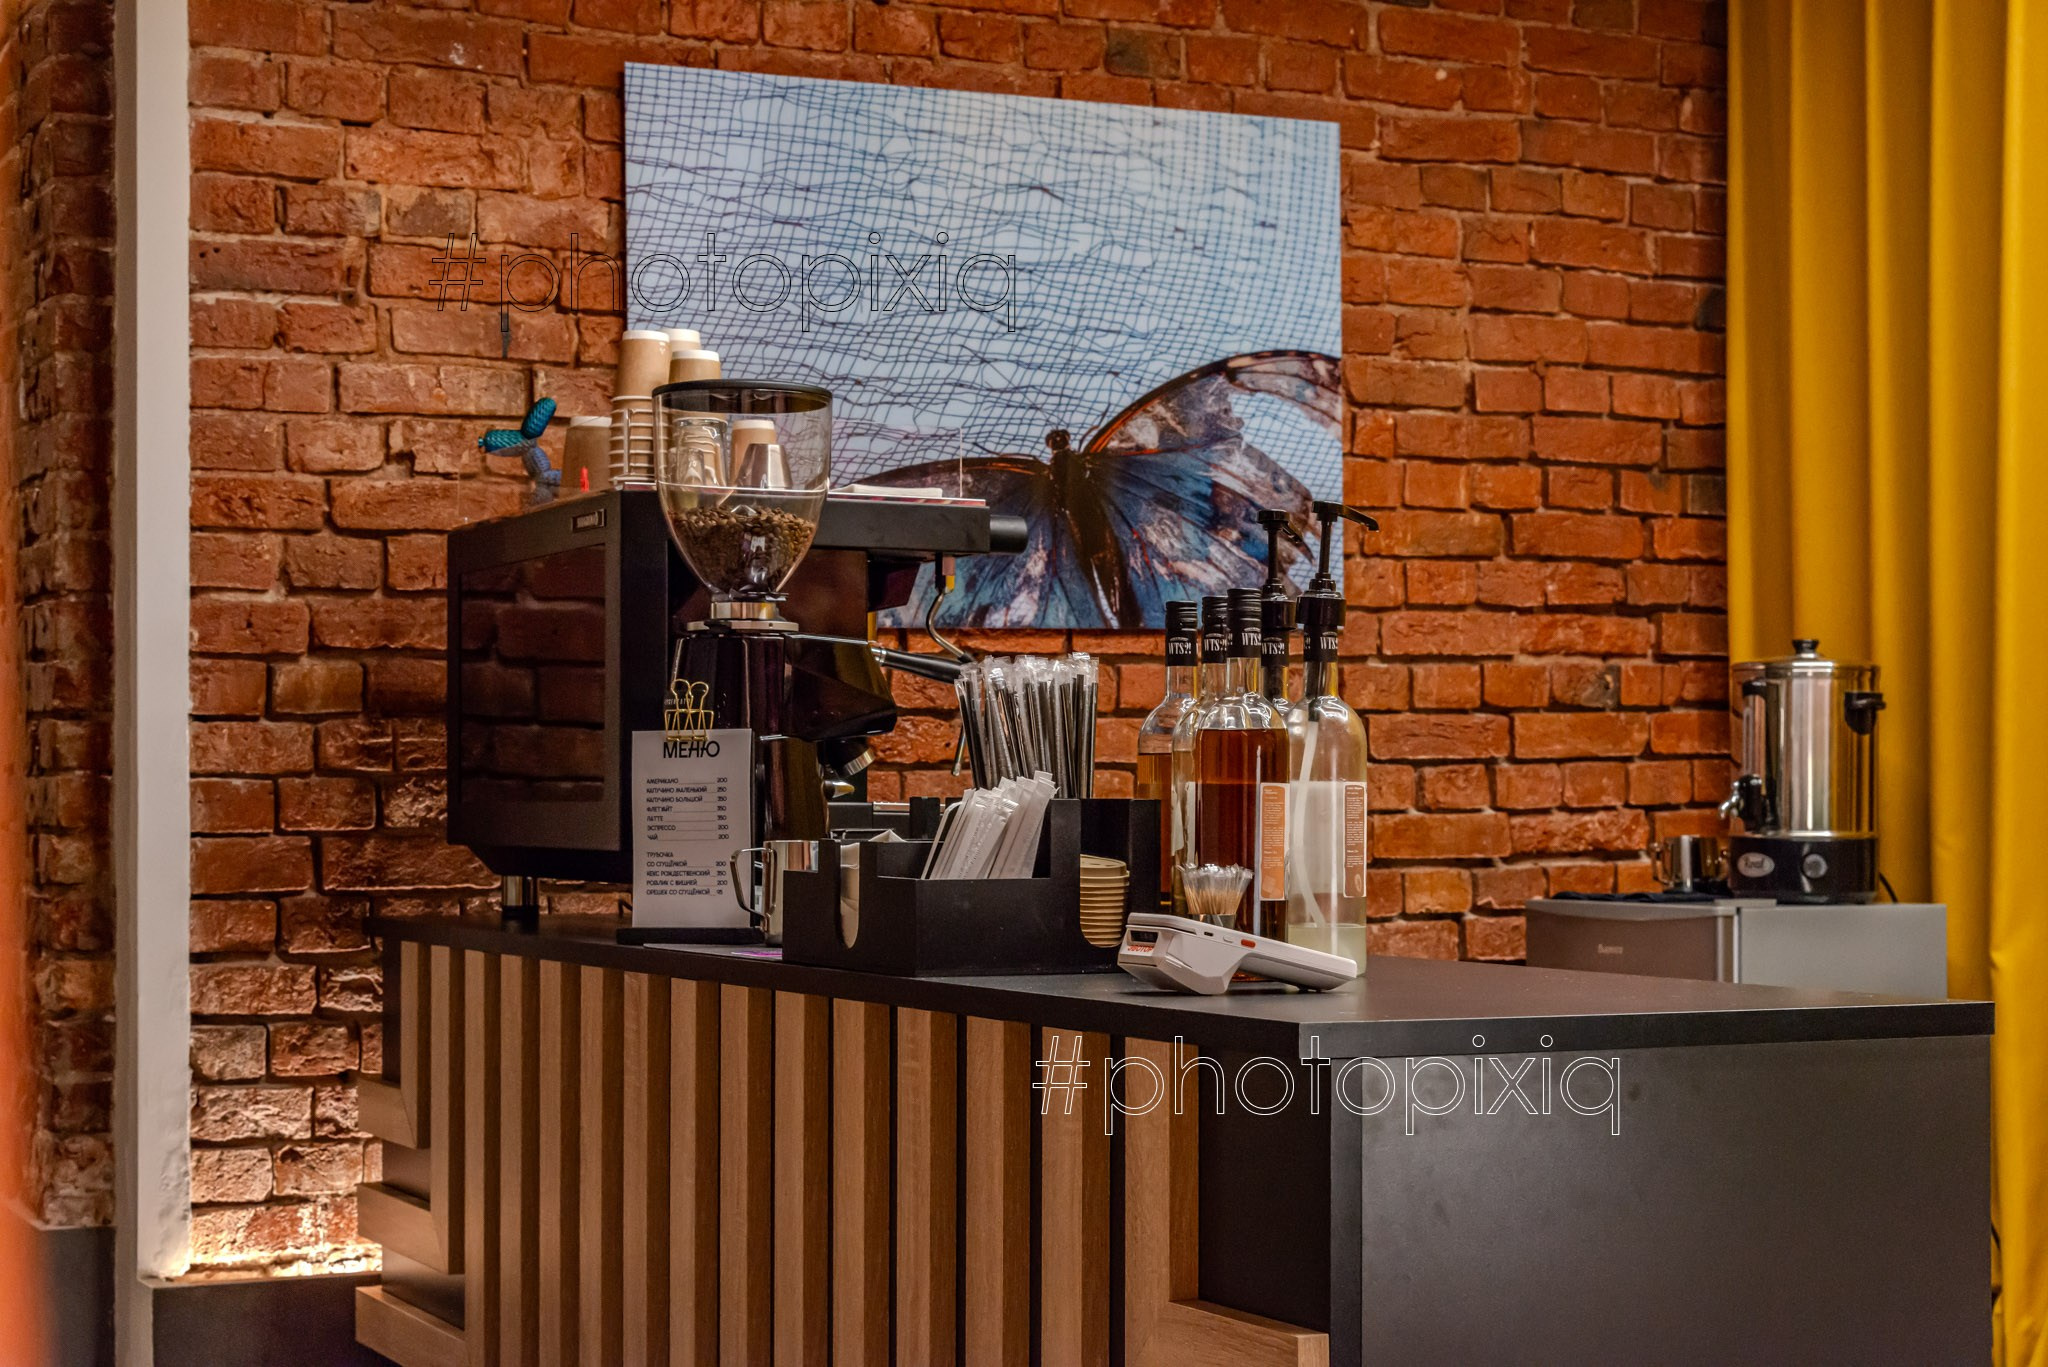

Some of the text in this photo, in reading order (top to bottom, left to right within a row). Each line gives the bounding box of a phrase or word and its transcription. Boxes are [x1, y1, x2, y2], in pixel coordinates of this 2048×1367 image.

[1169, 642, 1192, 655] WTS?!
[1262, 642, 1285, 654] WTS?!
[663, 740, 720, 758] МЕНЮ
